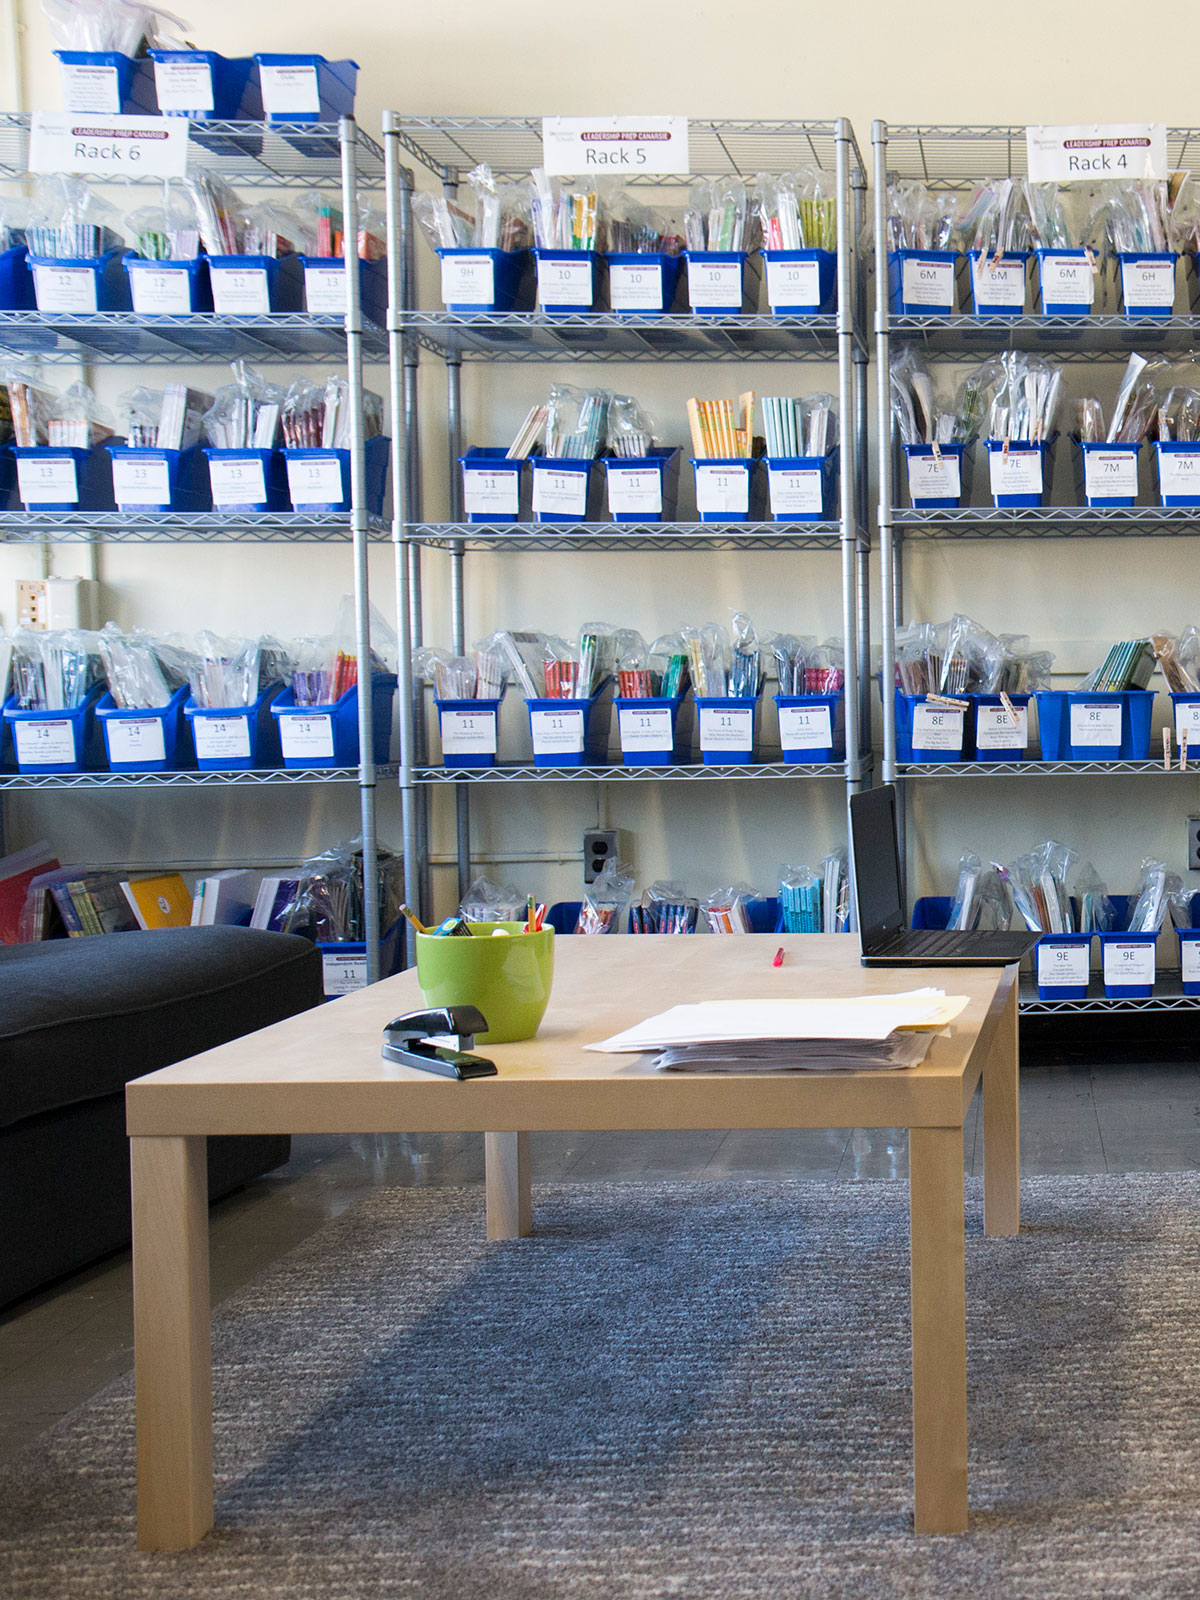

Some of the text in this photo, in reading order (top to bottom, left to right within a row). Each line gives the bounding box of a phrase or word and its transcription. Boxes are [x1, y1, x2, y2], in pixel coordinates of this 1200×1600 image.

[73, 127, 114, 136] LEADERSHIP
[1067, 138, 1149, 148] LEADERSHIP PREP CANARSIE
[75, 143, 140, 160] Rack 6
[586, 147, 646, 164] Rack 5
[1069, 154, 1127, 171] Rack 4
[460, 268, 474, 277] 9H
[559, 270, 571, 280] 10
[709, 272, 721, 281] 10
[788, 271, 799, 280] 10
[920, 270, 936, 279] 6M
[990, 270, 1007, 280] 6M
[1060, 269, 1076, 278] 6M
[1142, 272, 1155, 281] 6H
[59, 276, 72, 286] 12
[154, 278, 166, 287] 12
[234, 278, 246, 287] 12
[327, 278, 338, 287] 13
[631, 274, 642, 283] 10
[927, 463, 938, 473] 7E
[1010, 459, 1021, 468] 7E
[1104, 464, 1119, 472] 7M
[1178, 461, 1193, 469] 7M
[40, 468, 53, 477] 13
[135, 469, 147, 478] 13
[231, 469, 242, 478] 13
[309, 469, 320, 478] 13
[485, 479, 496, 488] 11
[555, 480, 565, 489] 11
[630, 478, 640, 487] 11
[718, 478, 728, 486] 11
[790, 479, 800, 488] 11
[800, 716, 809, 725] 11
[932, 716, 943, 725] 8E
[996, 715, 1007, 724] 8E
[1090, 712, 1101, 720] 8E
[463, 720, 474, 728] 11
[552, 719, 563, 728] 11
[641, 718, 651, 727] 11
[721, 717, 731, 726] 11
[128, 727, 140, 736] 14
[214, 724, 226, 732] 14
[300, 724, 310, 732] 14
[37, 729, 50, 738] 14
[1057, 952, 1068, 961] 9E
[1123, 952, 1134, 960] 9E
[343, 970, 355, 979] 11
